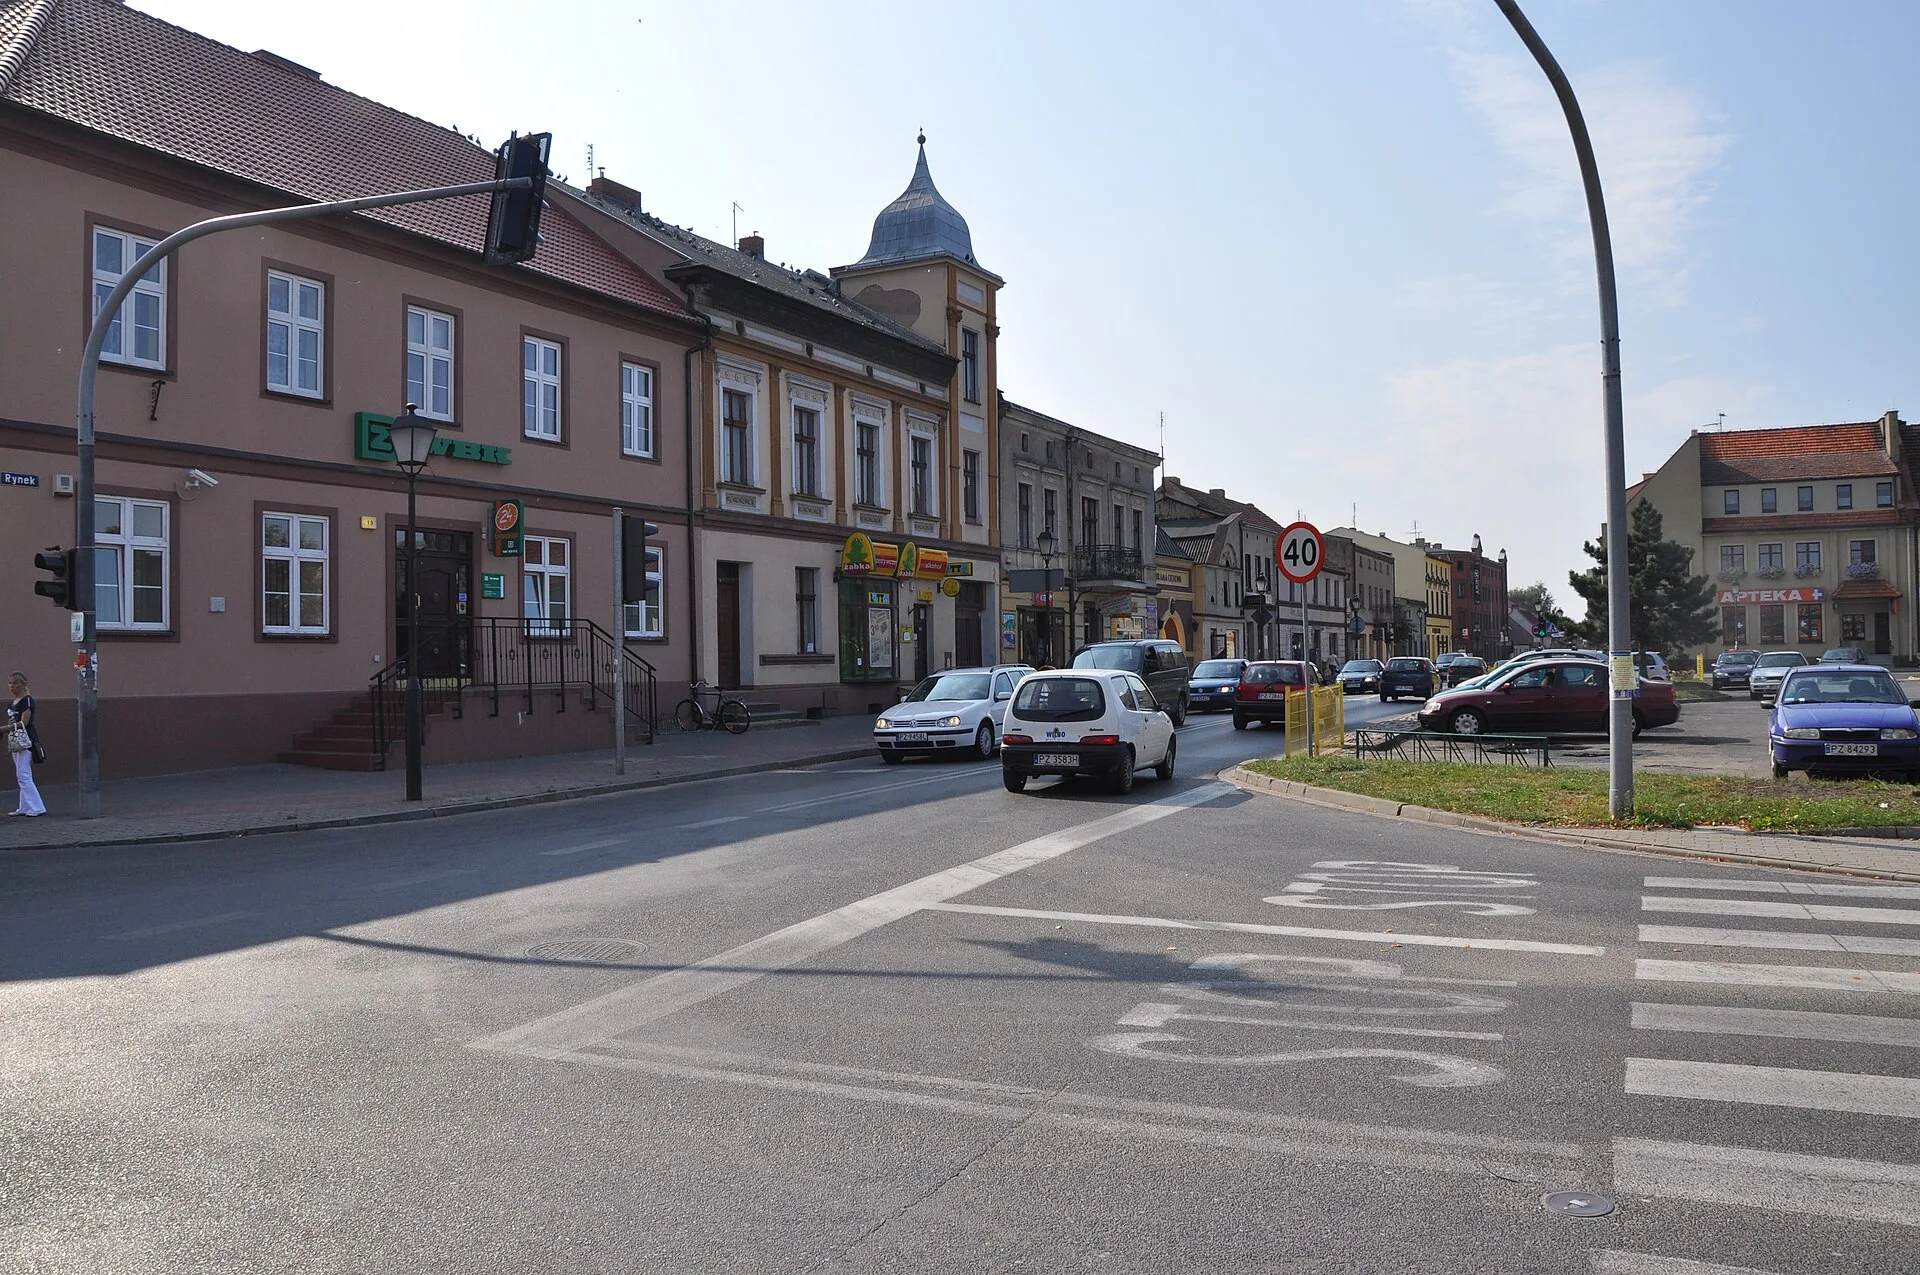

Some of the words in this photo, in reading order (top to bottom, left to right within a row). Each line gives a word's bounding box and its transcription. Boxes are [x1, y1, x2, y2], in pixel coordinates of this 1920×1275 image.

[5, 473, 36, 485] Rynek
[500, 509, 513, 523] 24
[1283, 537, 1317, 567] 40
[844, 562, 870, 570] żabka
[1719, 589, 1803, 603] APTEKA
[1831, 744, 1843, 754] PZ
[1846, 744, 1876, 755] 84293
[1039, 754, 1051, 764] PZ
[1053, 755, 1078, 764] 3583H
